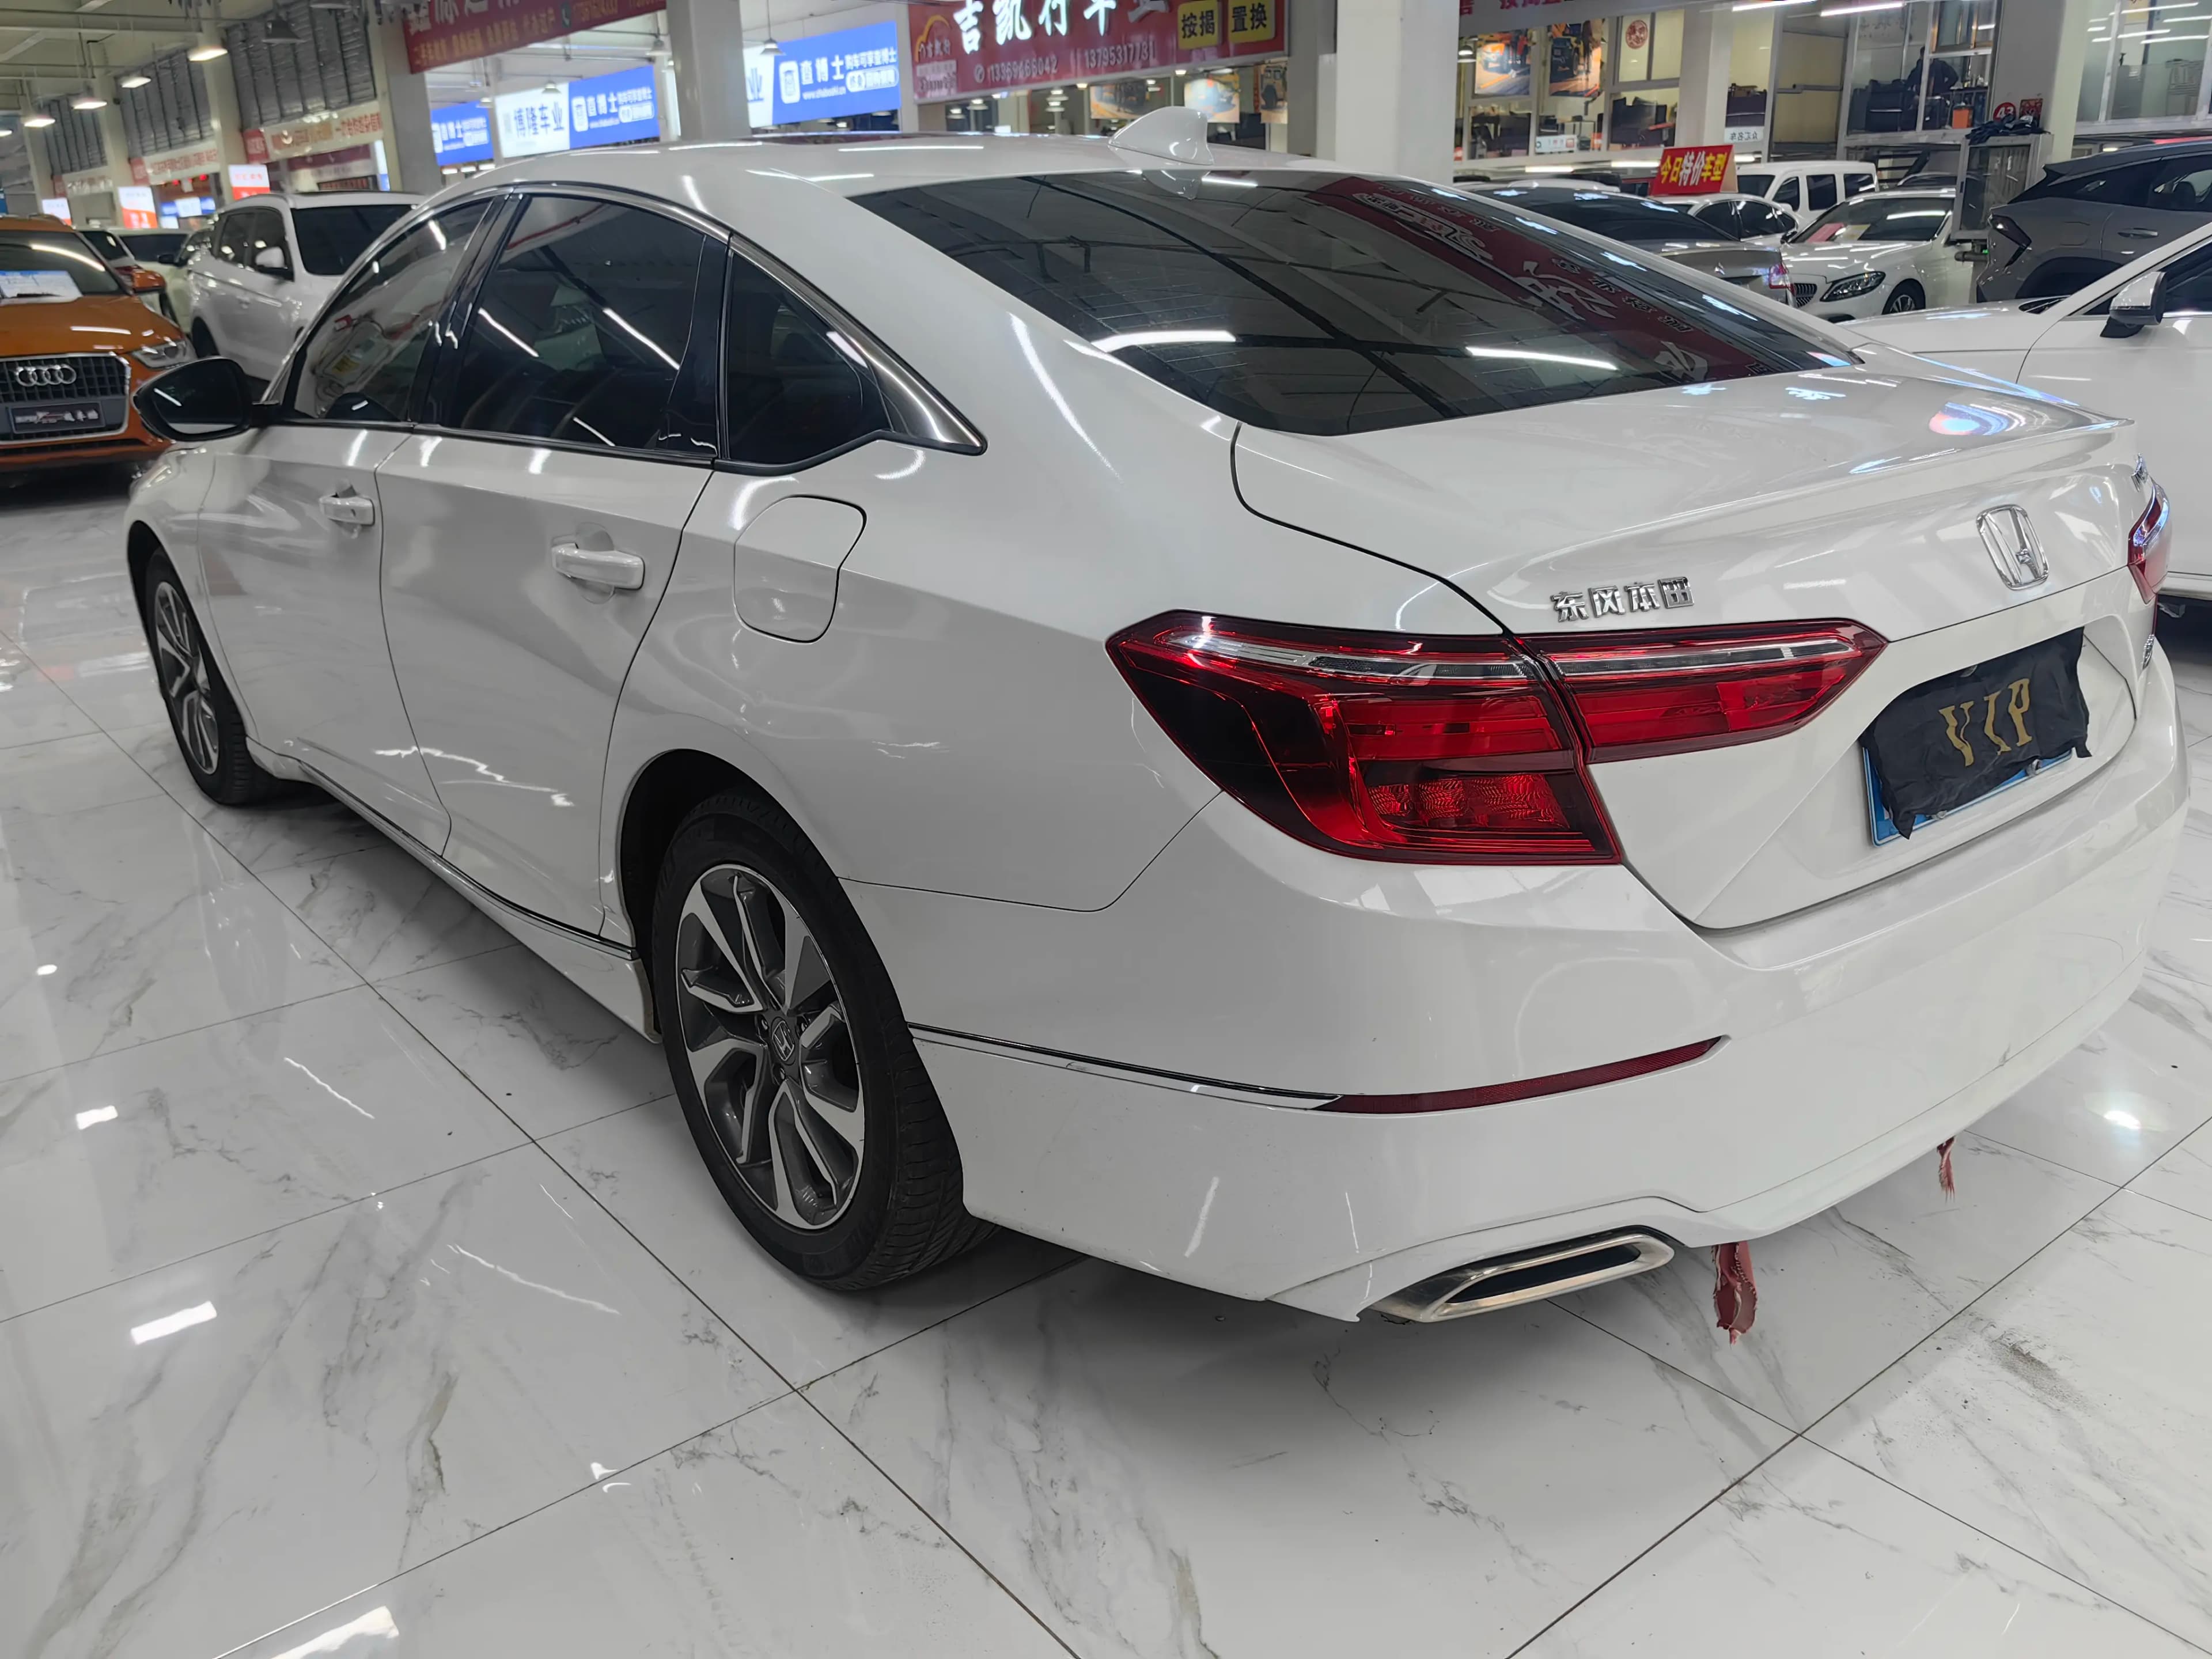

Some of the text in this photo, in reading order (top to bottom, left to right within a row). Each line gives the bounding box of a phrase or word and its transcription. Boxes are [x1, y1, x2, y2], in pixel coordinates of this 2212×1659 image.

[1181, 10, 1215, 39] 按揭
[1232, 3, 1267, 33] 置换
[1660, 150, 1728, 187] 今日特价车型
[1550, 576, 1695, 623] 东风本田
[1938, 677, 2032, 767] VIP
